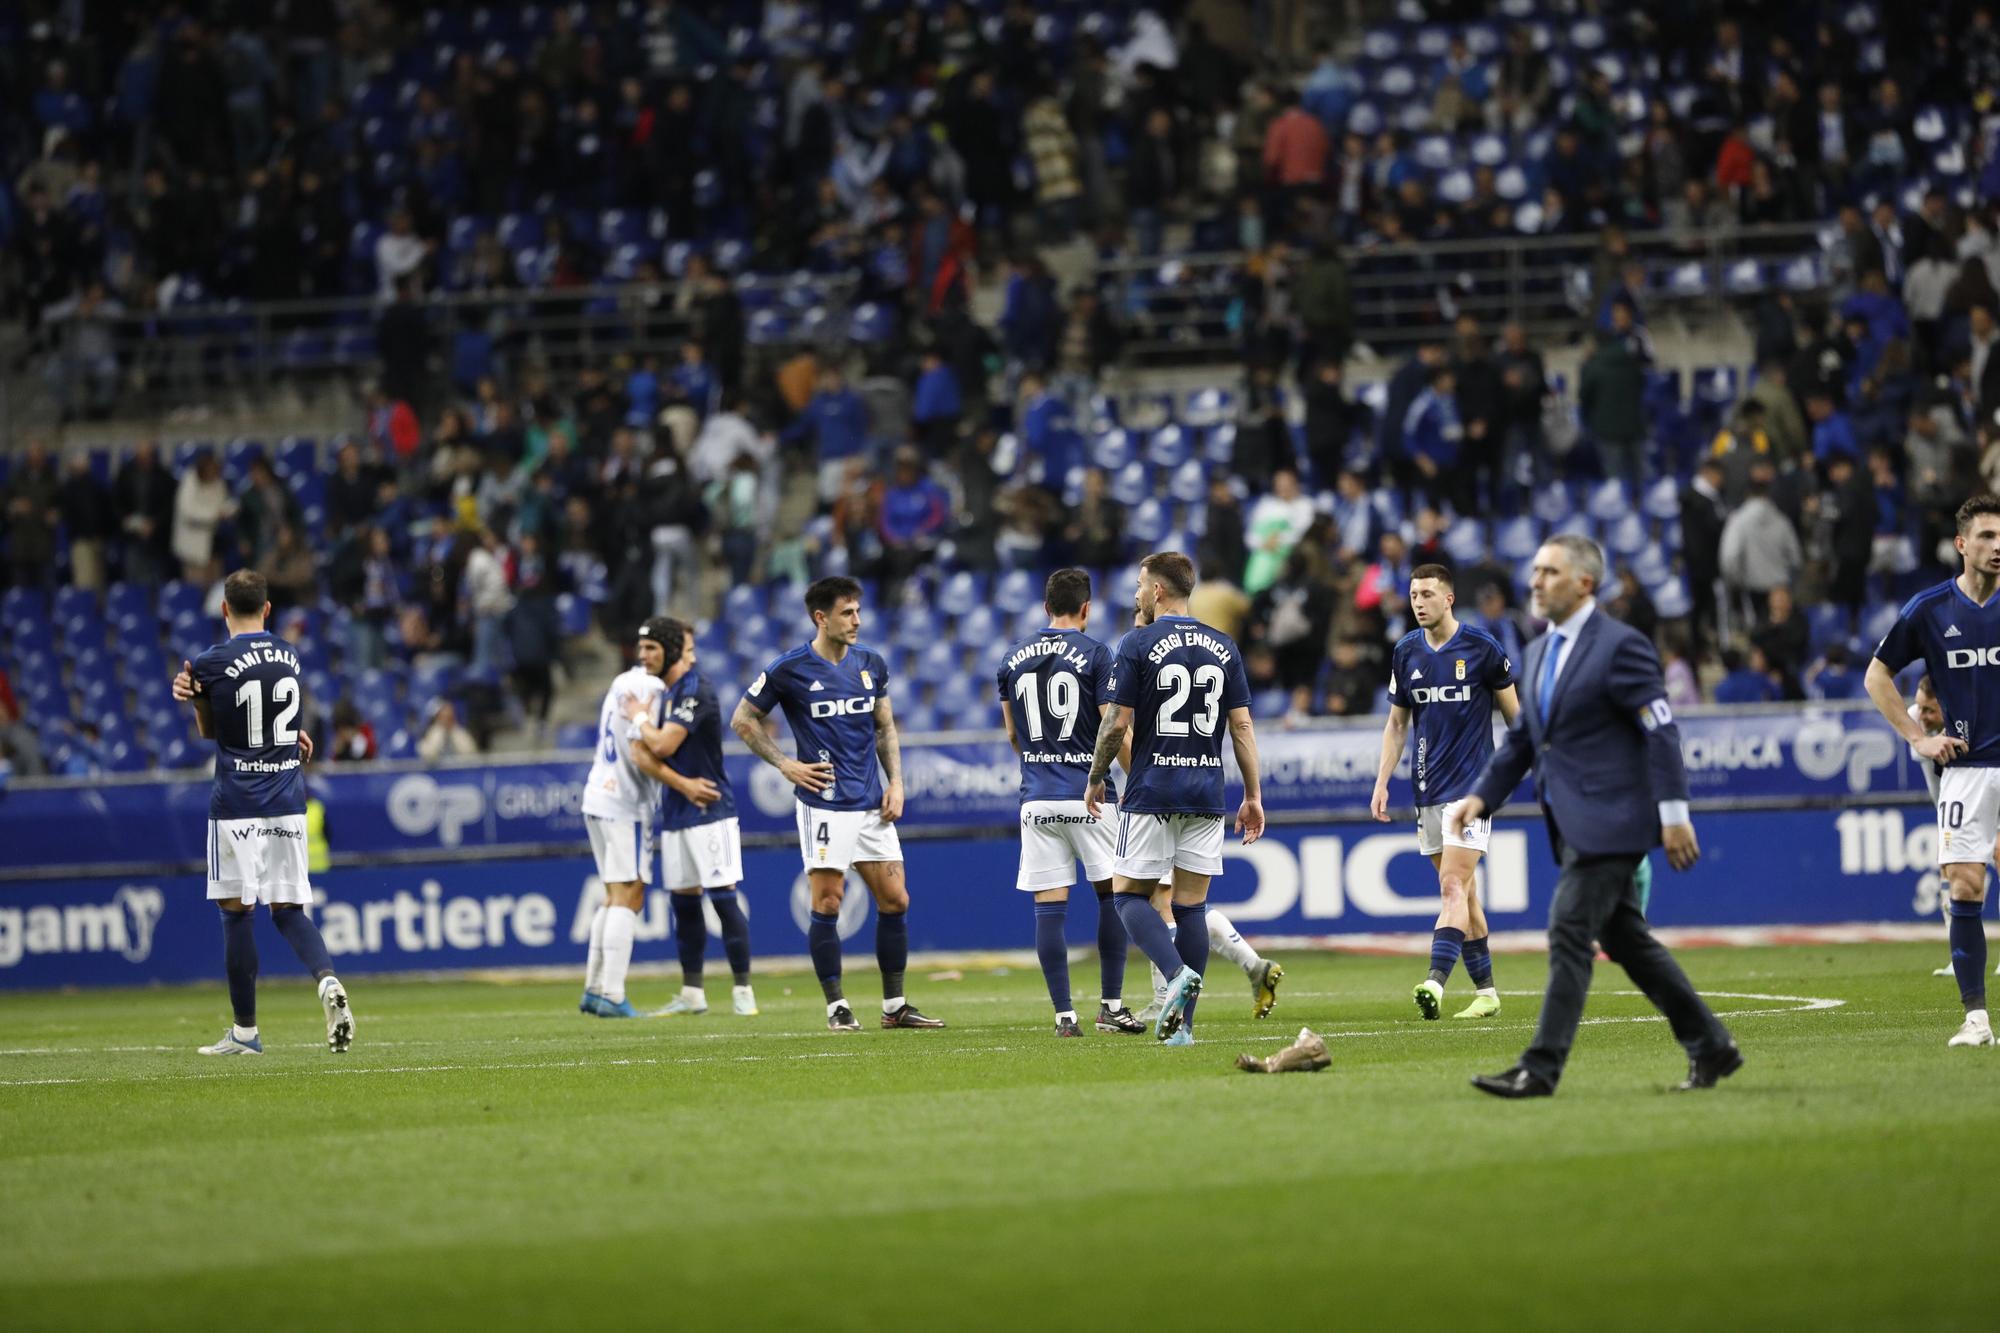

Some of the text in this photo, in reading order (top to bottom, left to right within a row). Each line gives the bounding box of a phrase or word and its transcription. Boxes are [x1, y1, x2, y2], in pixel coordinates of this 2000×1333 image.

[1008, 641, 1068, 671] MONTORO
[1148, 632, 1232, 665] SERGI ENRICH
[224, 649, 301, 679] DANI CALVO
[1014, 671, 1080, 742] 19
[1156, 663, 1226, 738] 23
[1411, 685, 1472, 704] DIGI
[235, 676, 300, 749] 12
[810, 696, 876, 719] DIGI
[234, 758, 280, 773] Tartiere
[1064, 751, 1094, 764] Auto
[1152, 752, 1198, 767] Tartiere
[1034, 814, 1097, 825] FanSports
[1938, 800, 1964, 829] 10
[257, 827, 303, 841] FanSports
[816, 821, 830, 845] 4
